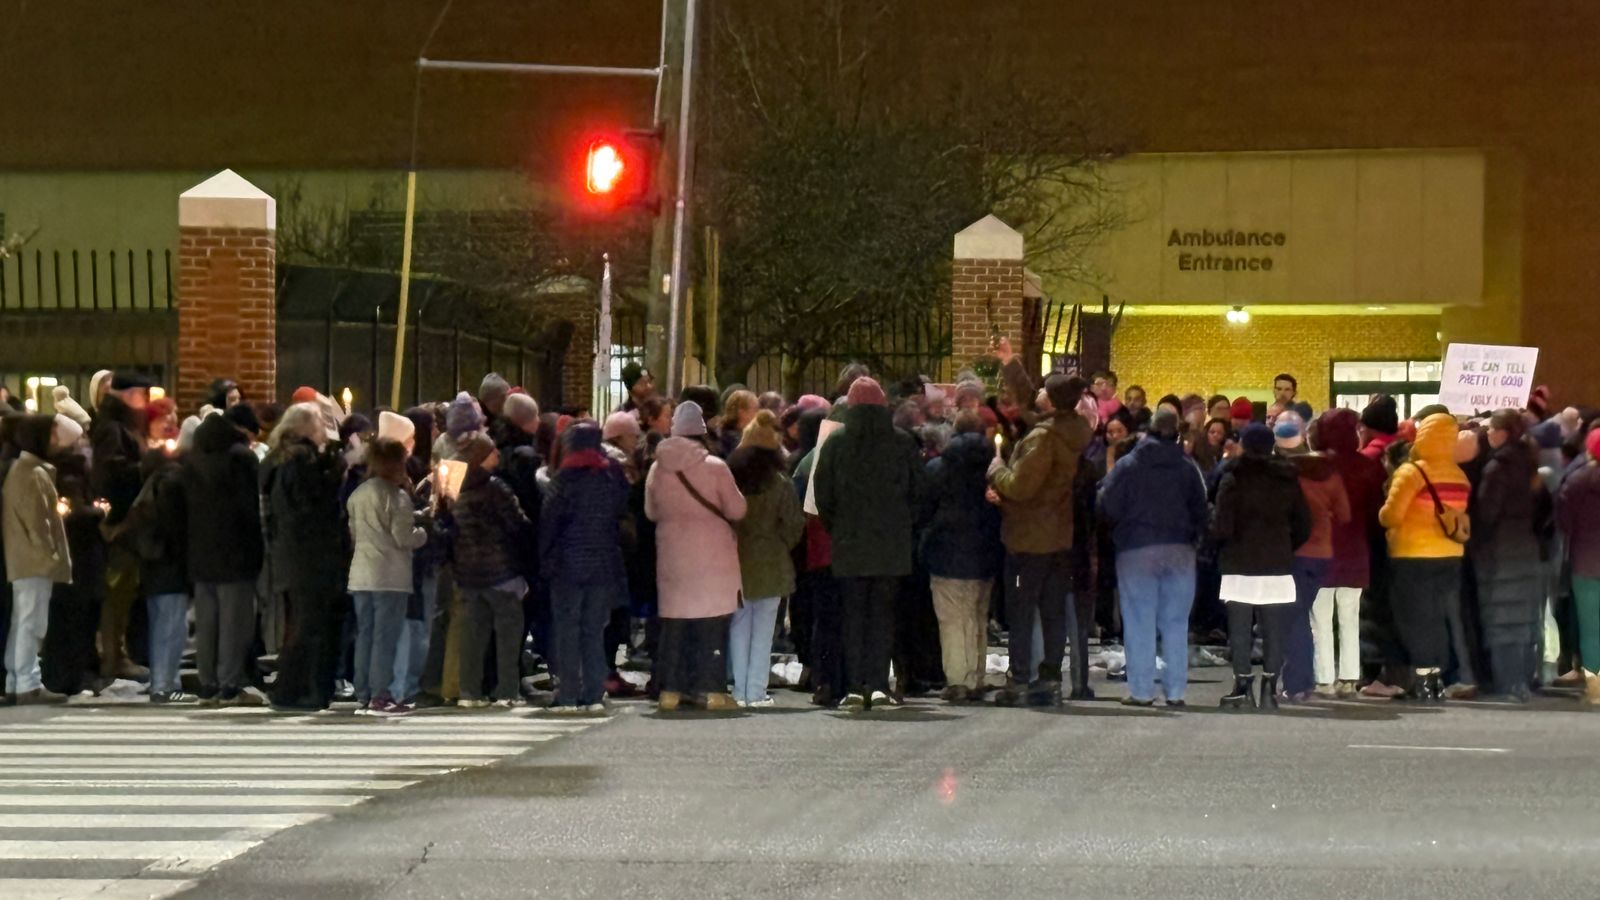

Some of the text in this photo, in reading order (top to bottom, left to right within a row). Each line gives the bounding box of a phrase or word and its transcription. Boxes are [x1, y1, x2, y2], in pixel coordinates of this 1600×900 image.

[1167, 228, 1286, 247] Ambulance
[1178, 253, 1273, 271] Entrance
[1462, 360, 1526, 374] WE CAN TELL
[1457, 373, 1489, 386] PRETTI
[1500, 375, 1523, 388] GOOD
[1470, 394, 1492, 405] UGLY
[1501, 395, 1520, 407] EVIL
